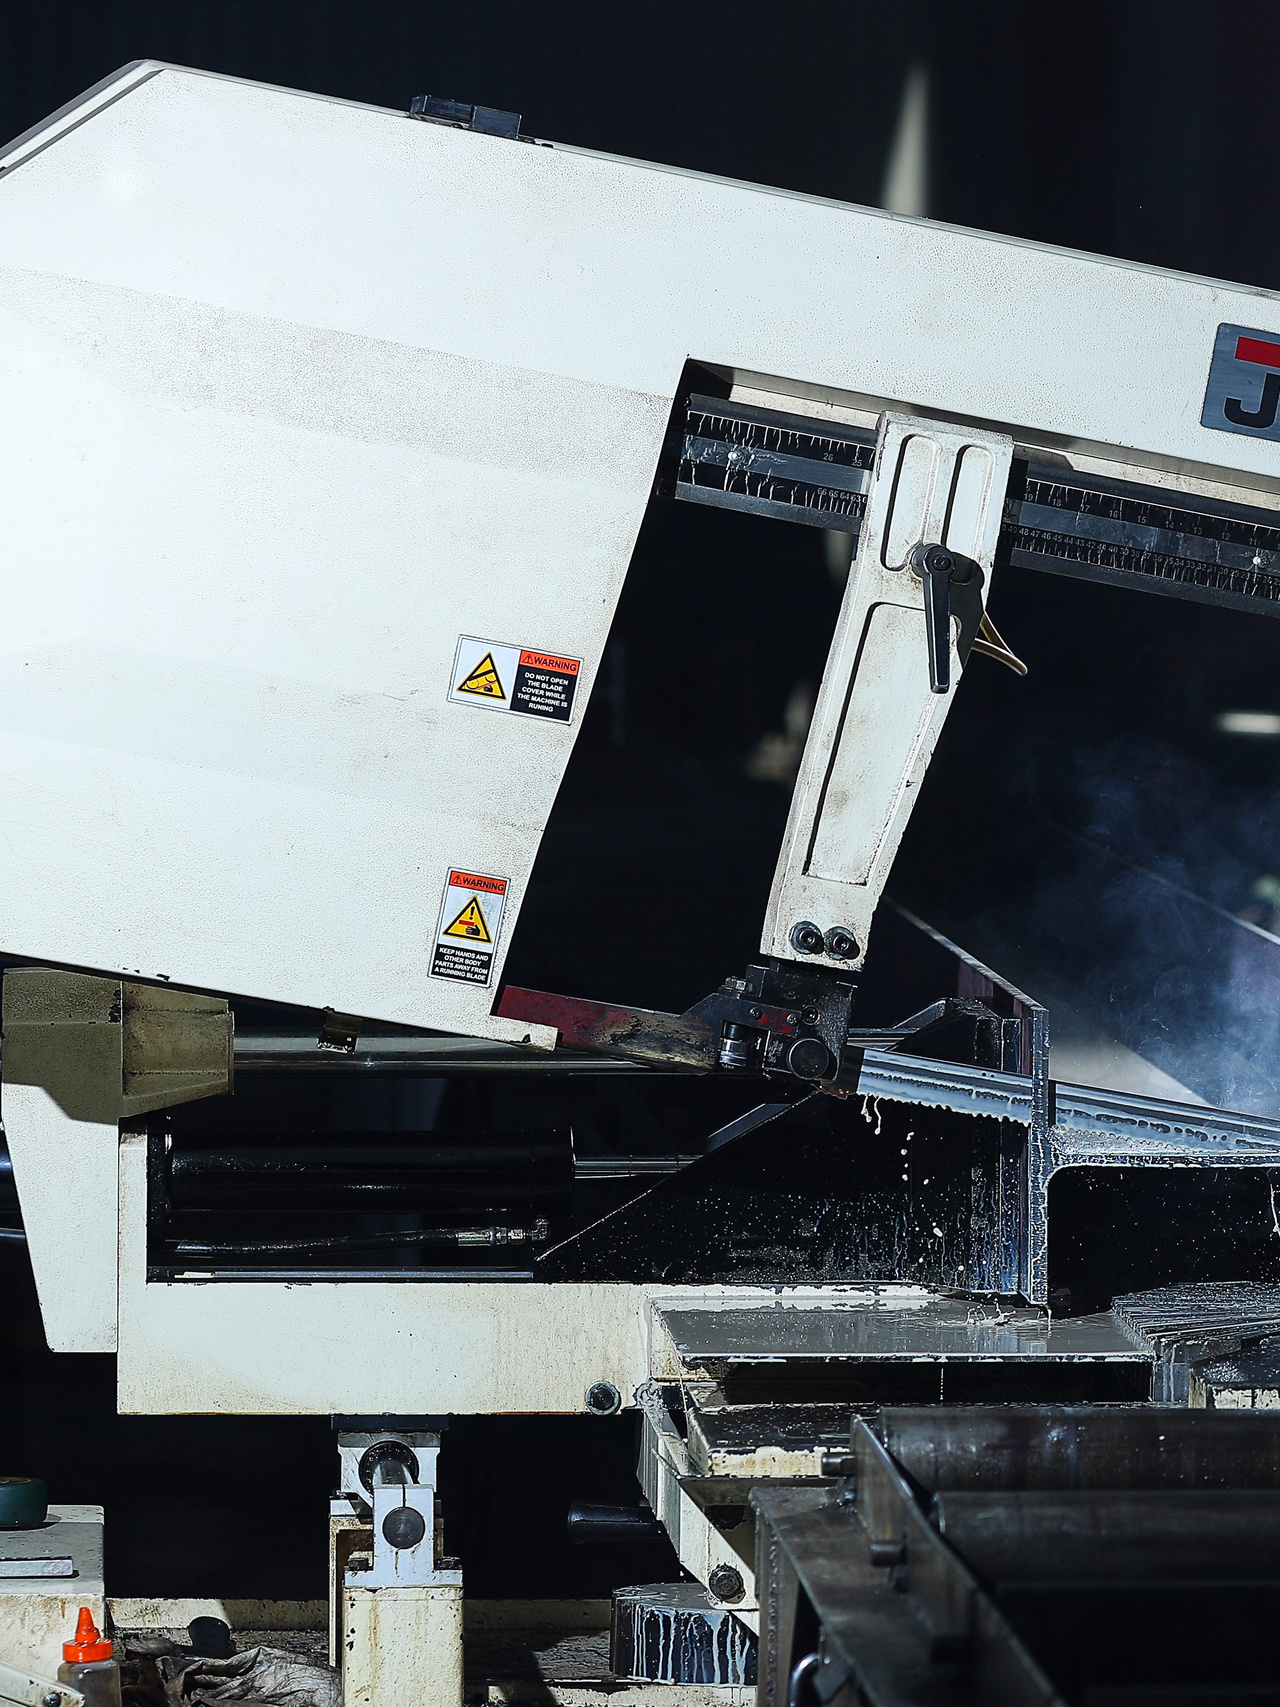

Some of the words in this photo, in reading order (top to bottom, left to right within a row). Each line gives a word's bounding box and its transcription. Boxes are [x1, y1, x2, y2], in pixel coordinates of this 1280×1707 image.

[823, 453, 834, 461] 26
[851, 459, 863, 467] 25
[817, 488, 827, 496] 66
[828, 490, 839, 498] 65
[839, 492, 850, 500] 64
[851, 494, 861, 503] 63
[1023, 493, 1034, 501] 19
[1052, 499, 1062, 507] 18
[1109, 510, 1118, 518] 16
[1137, 516, 1147, 524] 15
[1165, 521, 1174, 529] 14
[1193, 526, 1203, 535] 13
[1221, 532, 1231, 541] 12
[1019, 528, 1029, 536] 48
[1030, 530, 1040, 538] 47
[1041, 532, 1052, 540] 46
[1052, 534, 1063, 542] 45
[1064, 536, 1074, 545] 44
[1075, 538, 1085, 546] 43
[1086, 541, 1096, 549] 42
[1186, 560, 1196, 568] 33
[533, 656, 576, 671] WARNING
[524, 671, 535, 679] DO
[535, 673, 549, 681] NOT
[549, 676, 568, 685] OPEN
[527, 679, 540, 687] THE
[541, 682, 563, 691] BLADE
[516, 692, 530, 700] THE
[530, 695, 560, 706] MACHINE
[521, 685, 544, 695] COVER
[545, 690, 565, 699] WHILE
[528, 702, 553, 712] RUNING
[462, 877, 504, 891] WARNING
[443, 954, 464, 963] OTHER
[464, 958, 481, 966] BODY
[455, 950, 475, 958] HANDS
[475, 953, 488, 961] AND
[434, 959, 453, 968] PARTS
[453, 963, 470, 971] AWAY
[470, 966, 488, 974] FROM
[439, 967, 465, 977] RUNNING
[466, 972, 485, 981] BLADE
